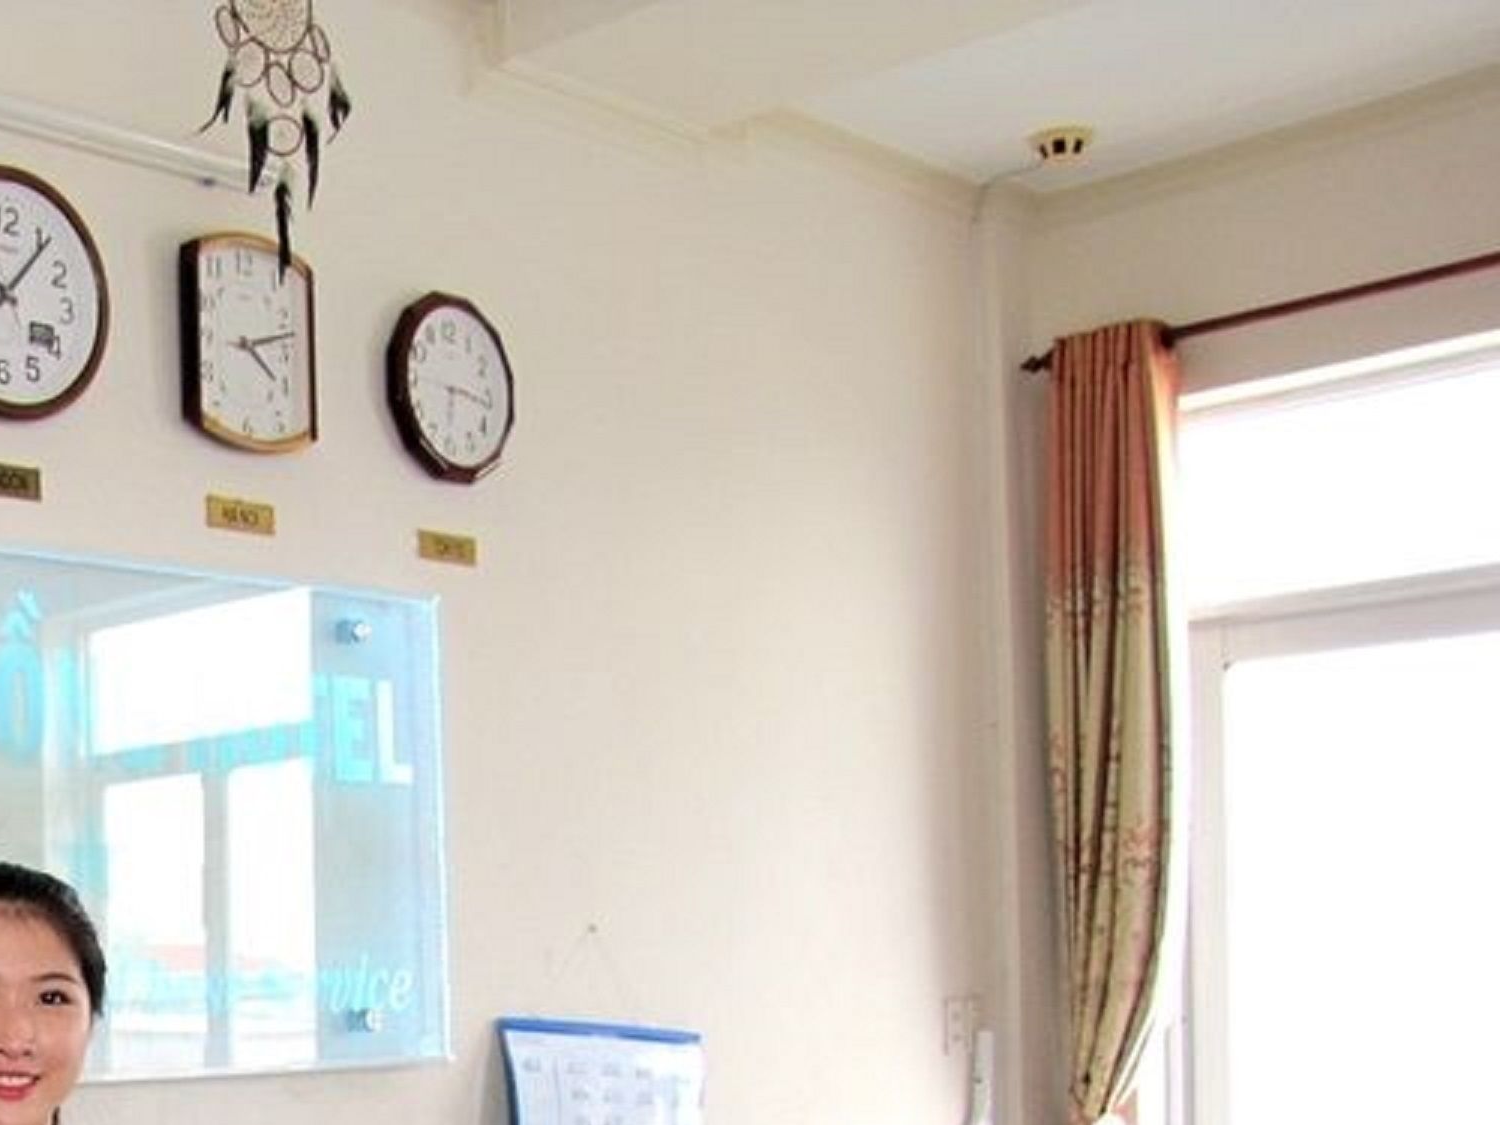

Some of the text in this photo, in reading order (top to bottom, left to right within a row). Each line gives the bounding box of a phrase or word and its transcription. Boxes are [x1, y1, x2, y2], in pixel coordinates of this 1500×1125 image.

[52, 260, 68, 288] 2
[60, 297, 74, 325] 3
[25, 355, 41, 383] 5
